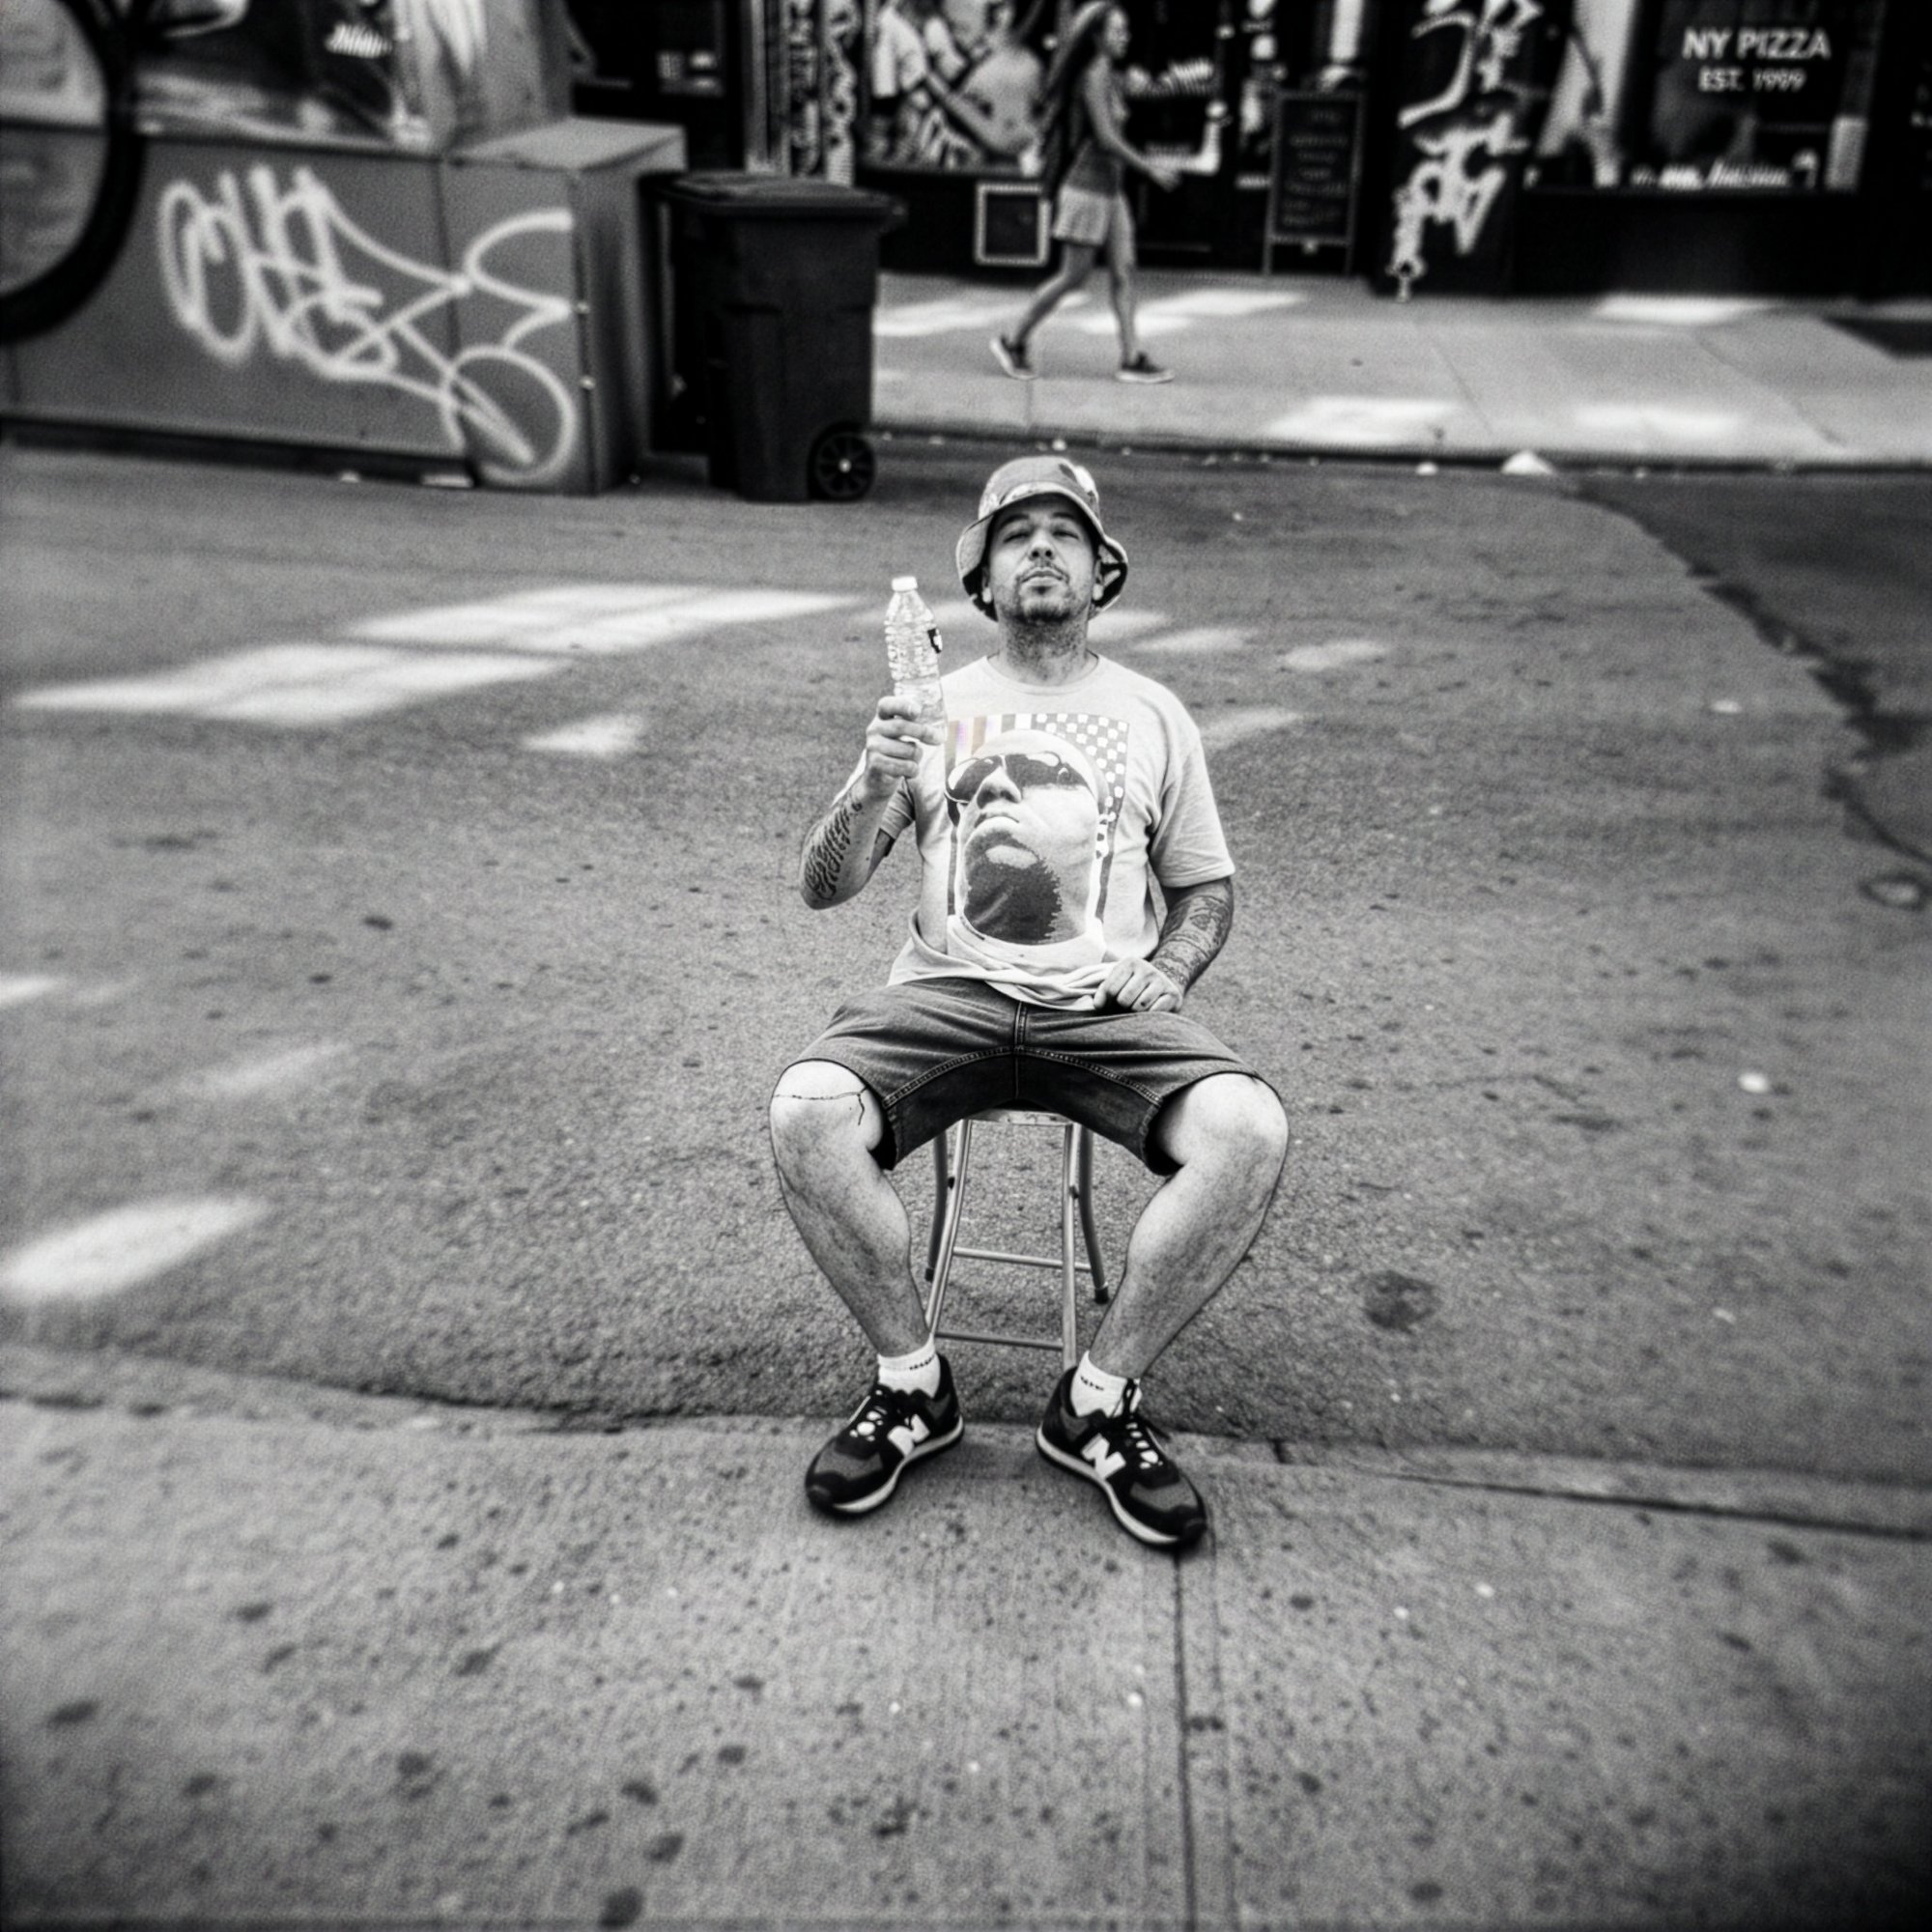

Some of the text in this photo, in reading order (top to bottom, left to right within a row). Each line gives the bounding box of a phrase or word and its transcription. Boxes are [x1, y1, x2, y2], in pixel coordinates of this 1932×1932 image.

[1683, 28, 1831, 59] NY PIZZA
[1699, 68, 1744, 91] EST.
[888, 1413, 930, 1456] N
[1081, 1434, 1126, 1481] N
